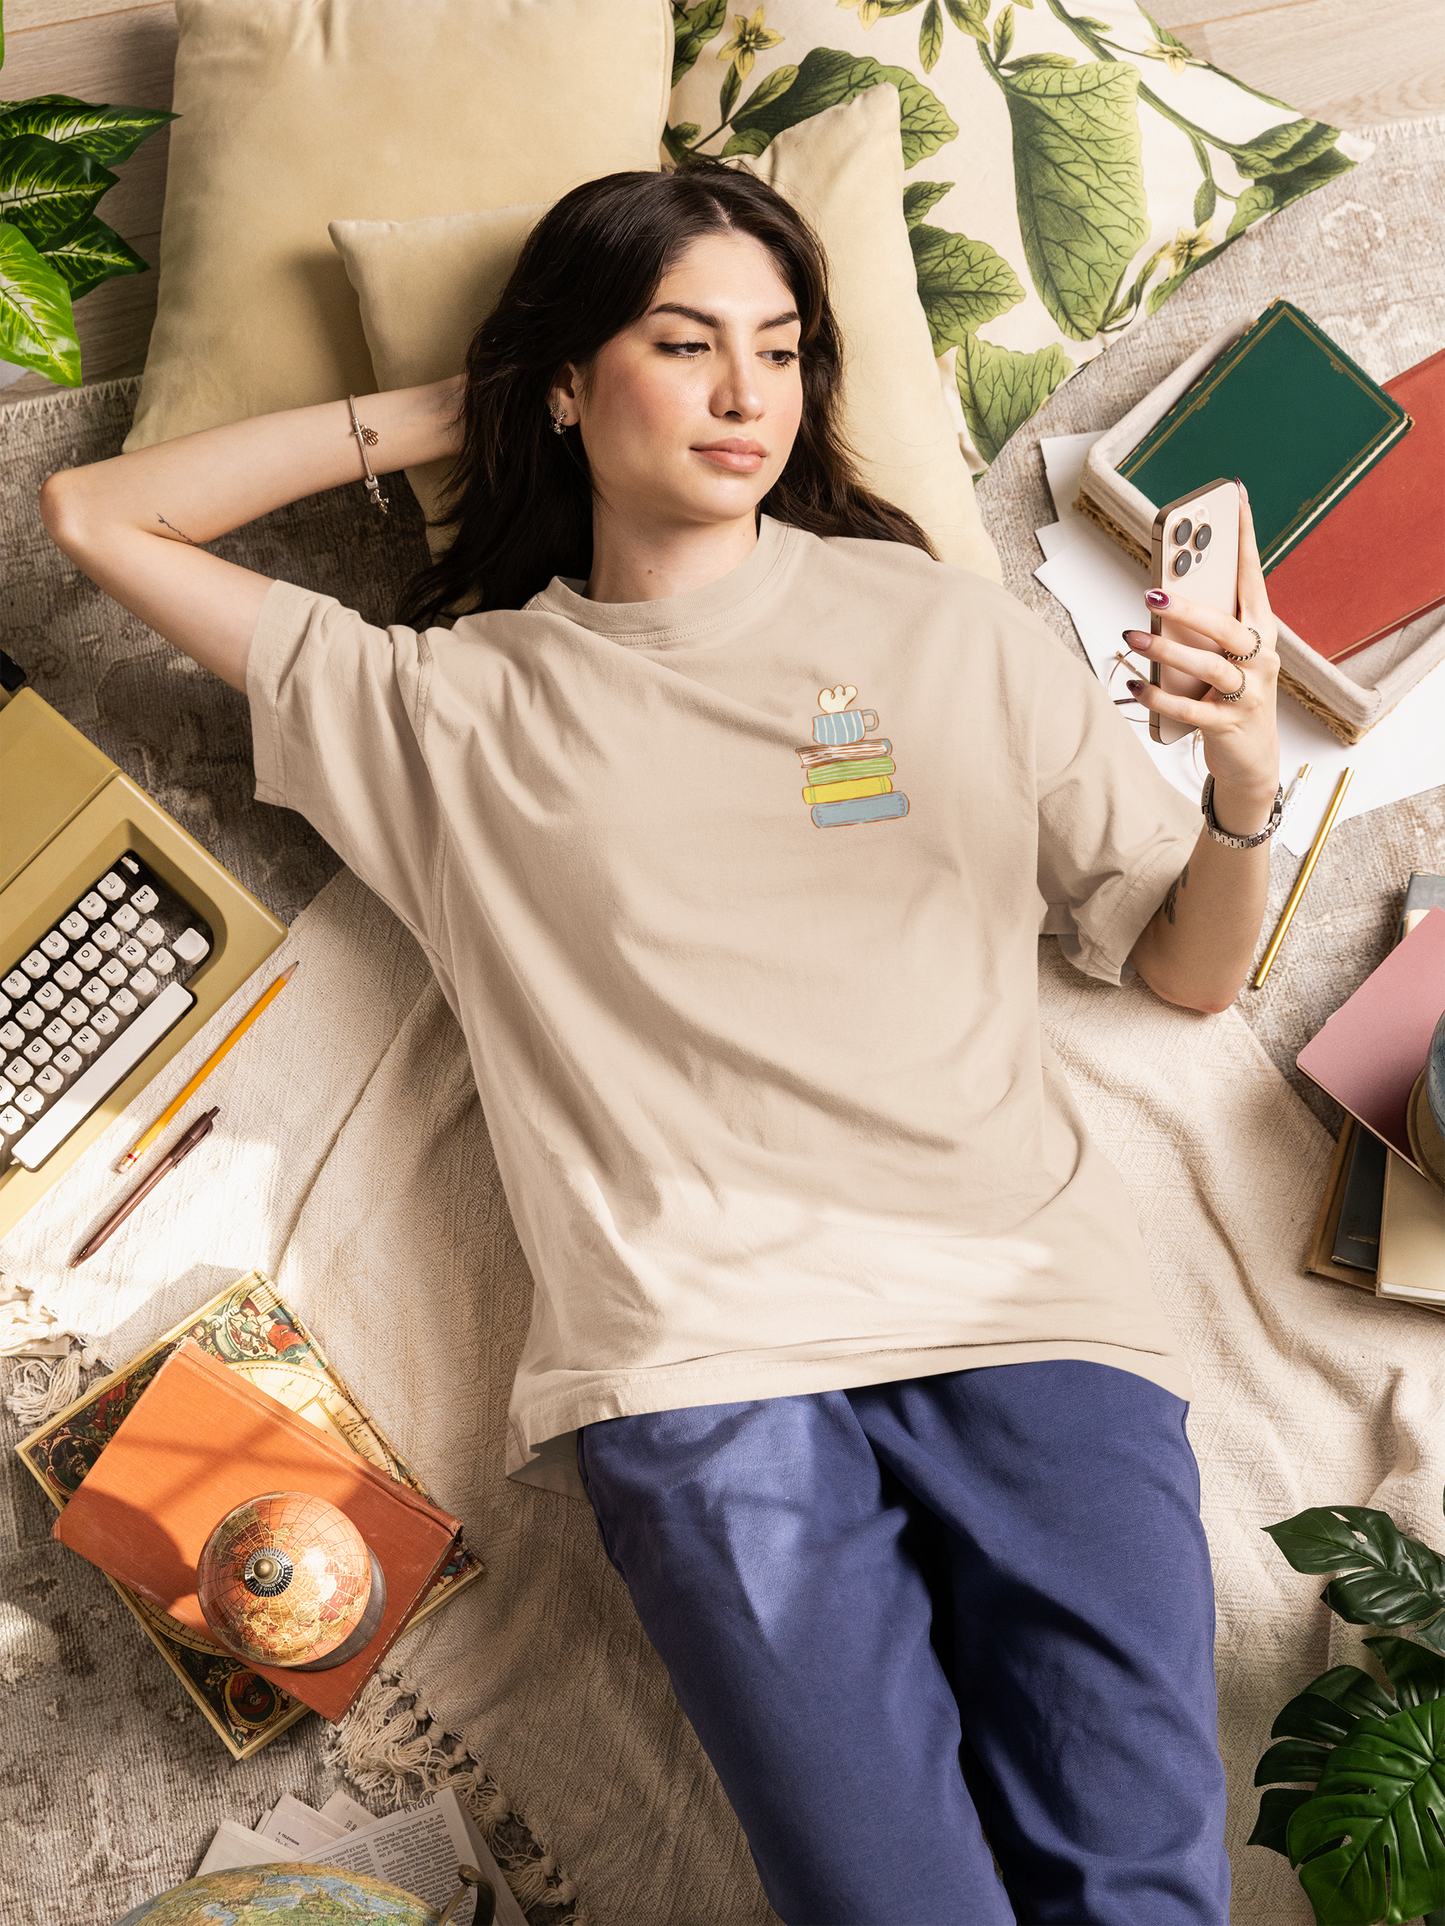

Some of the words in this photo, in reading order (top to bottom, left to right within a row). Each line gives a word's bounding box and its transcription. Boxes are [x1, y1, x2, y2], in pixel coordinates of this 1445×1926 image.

[100, 931, 107, 939] P
[81, 950, 90, 958] O
[126, 945, 136, 955] Ñ
[42, 989, 51, 997] U
[88, 984, 98, 993] K
[98, 1014, 108, 1023] M
[51, 1024, 60, 1033] H
[80, 1034, 89, 1042] N
[31, 1044, 41, 1053] G
[61, 1054, 70, 1062] B
[12, 1064, 18, 1073] F
[3, 1114, 12, 1122] X
[410, 1820, 423, 1829] good
[433, 1818, 445, 1826] been
[403, 1828, 420, 1837] achieve
[426, 1823, 446, 1834] economy
[372, 1835, 386, 1843] Chair
[379, 1833, 404, 1846] disinflation
[414, 1835, 430, 1844] overall
[431, 1836, 443, 1844] likely
[440, 1838, 452, 1846] keep
[376, 1845, 389, 1853] we've
[393, 1841, 414, 1853] resilience
[415, 1842, 427, 1850] keep
[419, 1842, 440, 1854] spending,
[331, 1848, 349, 1859] percent
[346, 1847, 368, 1858] partment
[404, 1850, 418, 1859] wages
[428, 1847, 446, 1856] remains
[443, 1849, 455, 1857] ment
[351, 1852, 370, 1863] through
[414, 1853, 429, 1861] strong
[433, 1853, 457, 1866] completely
[381, 1859, 395, 1868] prices
[383, 1861, 407, 1873] consumers
[414, 1860, 425, 1868] long
[443, 1859, 459, 1868] remain
[413, 1864, 431, 1873] without
[422, 1865, 443, 1876] skeptical
[414, 1873, 435, 1885] including
[435, 1874, 447, 1882] price
[419, 1886, 432, 1895] target
[427, 1887, 447, 1897] inflation
